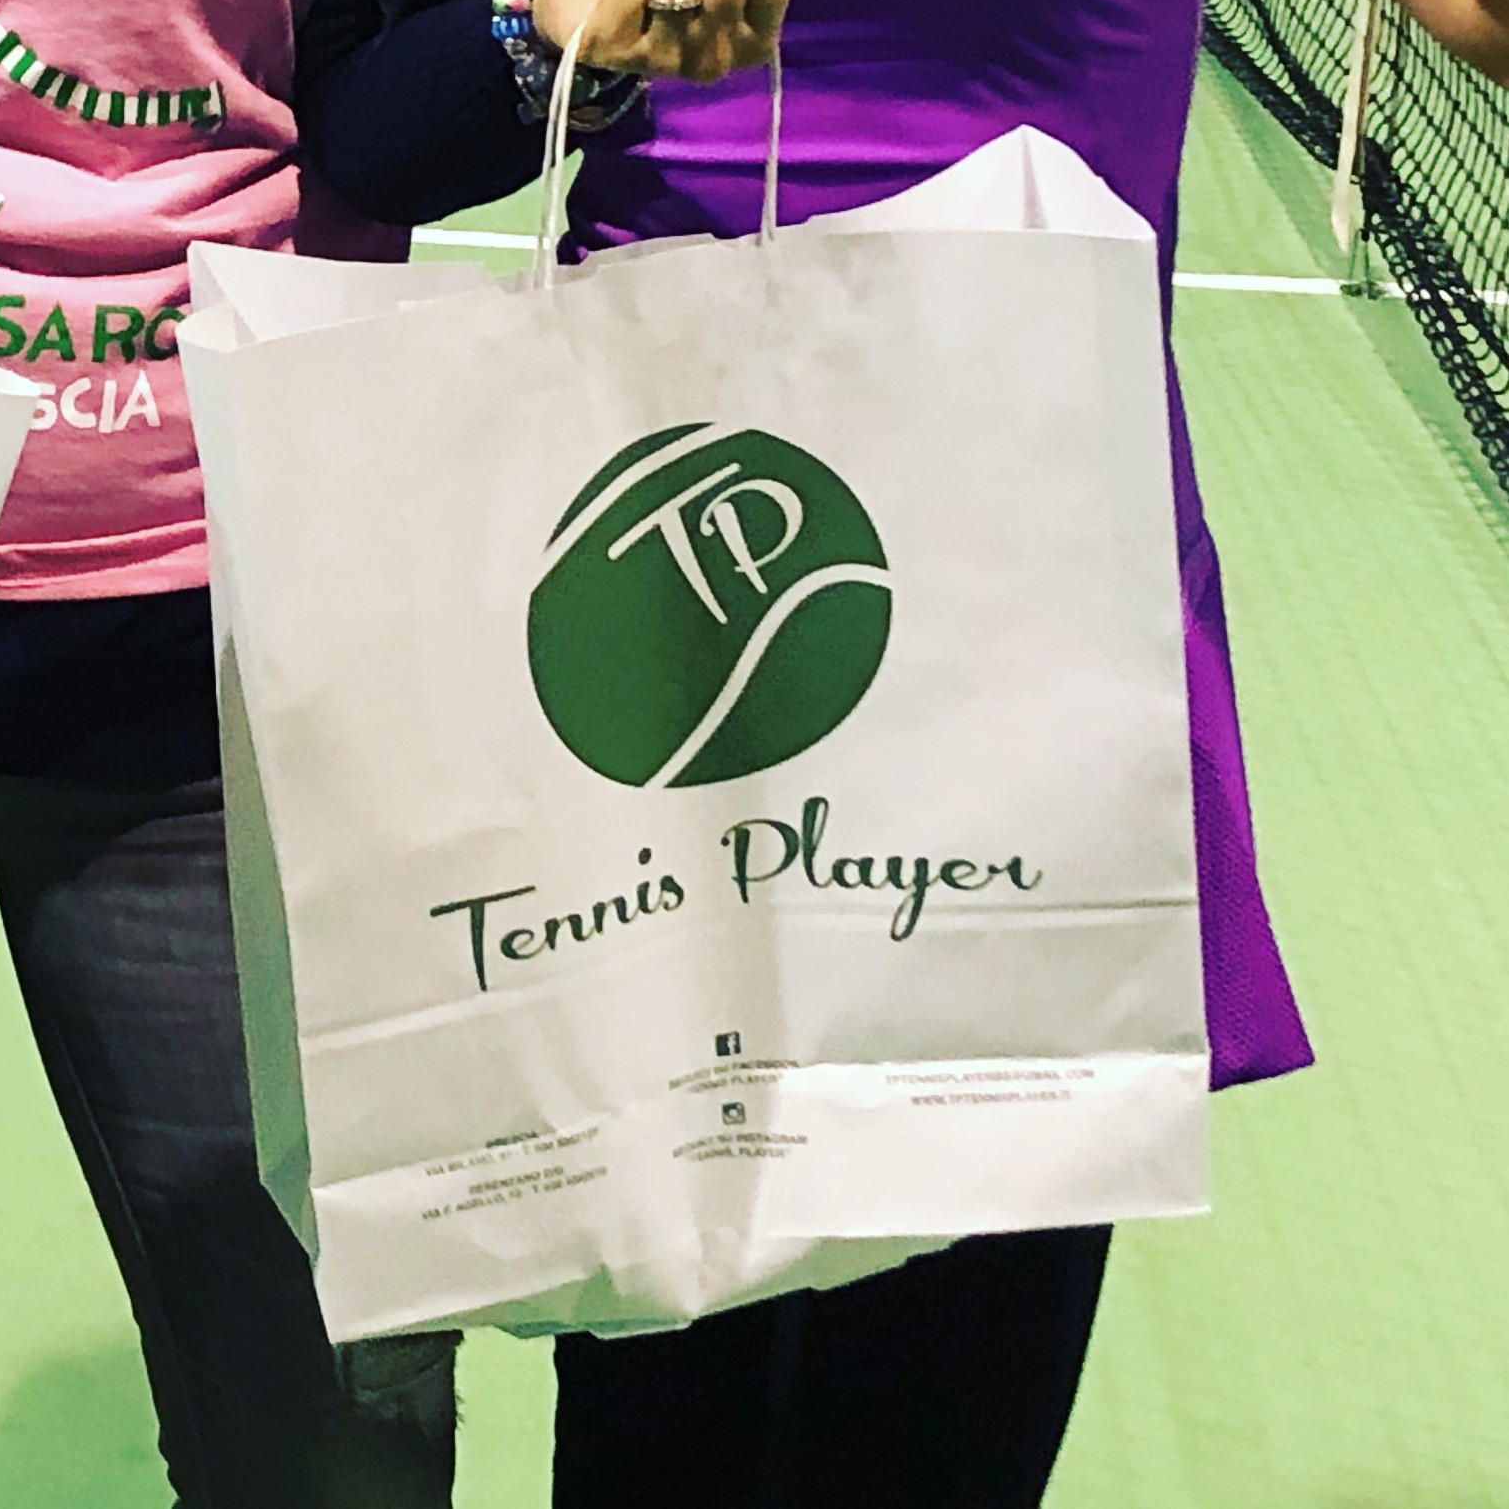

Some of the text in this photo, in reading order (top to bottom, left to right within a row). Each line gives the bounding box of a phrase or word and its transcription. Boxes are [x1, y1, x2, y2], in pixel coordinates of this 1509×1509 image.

[607, 461, 804, 625] TP
[430, 795, 1044, 992] Tennis Player
